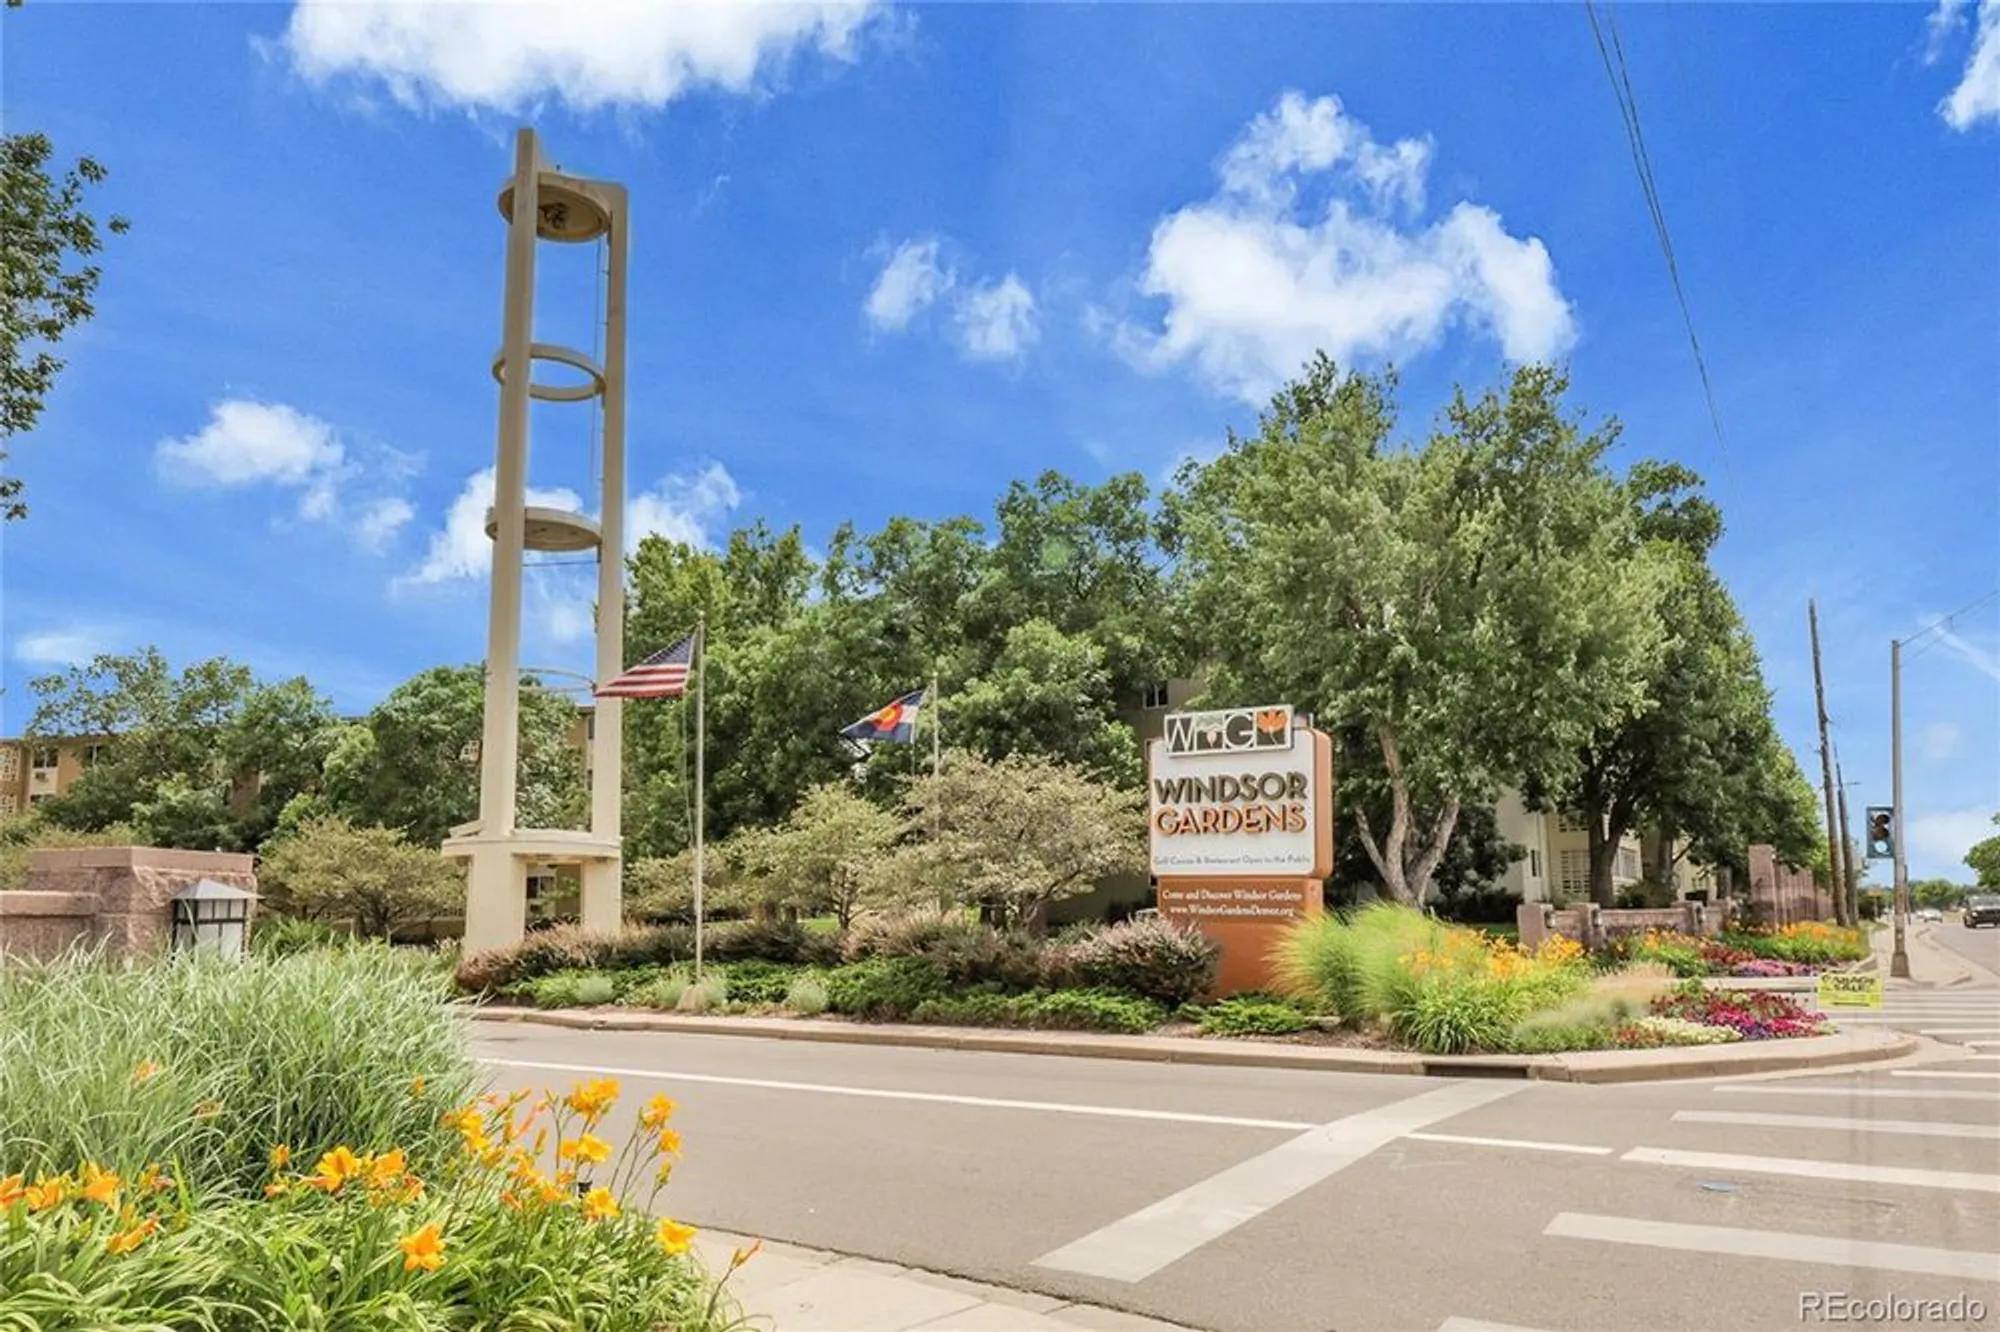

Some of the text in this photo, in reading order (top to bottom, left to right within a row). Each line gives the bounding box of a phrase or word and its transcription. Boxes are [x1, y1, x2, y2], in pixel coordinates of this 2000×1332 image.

[1154, 771, 1308, 804] WINDSOR
[1155, 803, 1307, 836] GARDENS
[1242, 854, 1263, 866] Open
[1273, 855, 1285, 864] the
[1162, 888, 1302, 901] Come and Discover Windsor Gardens
